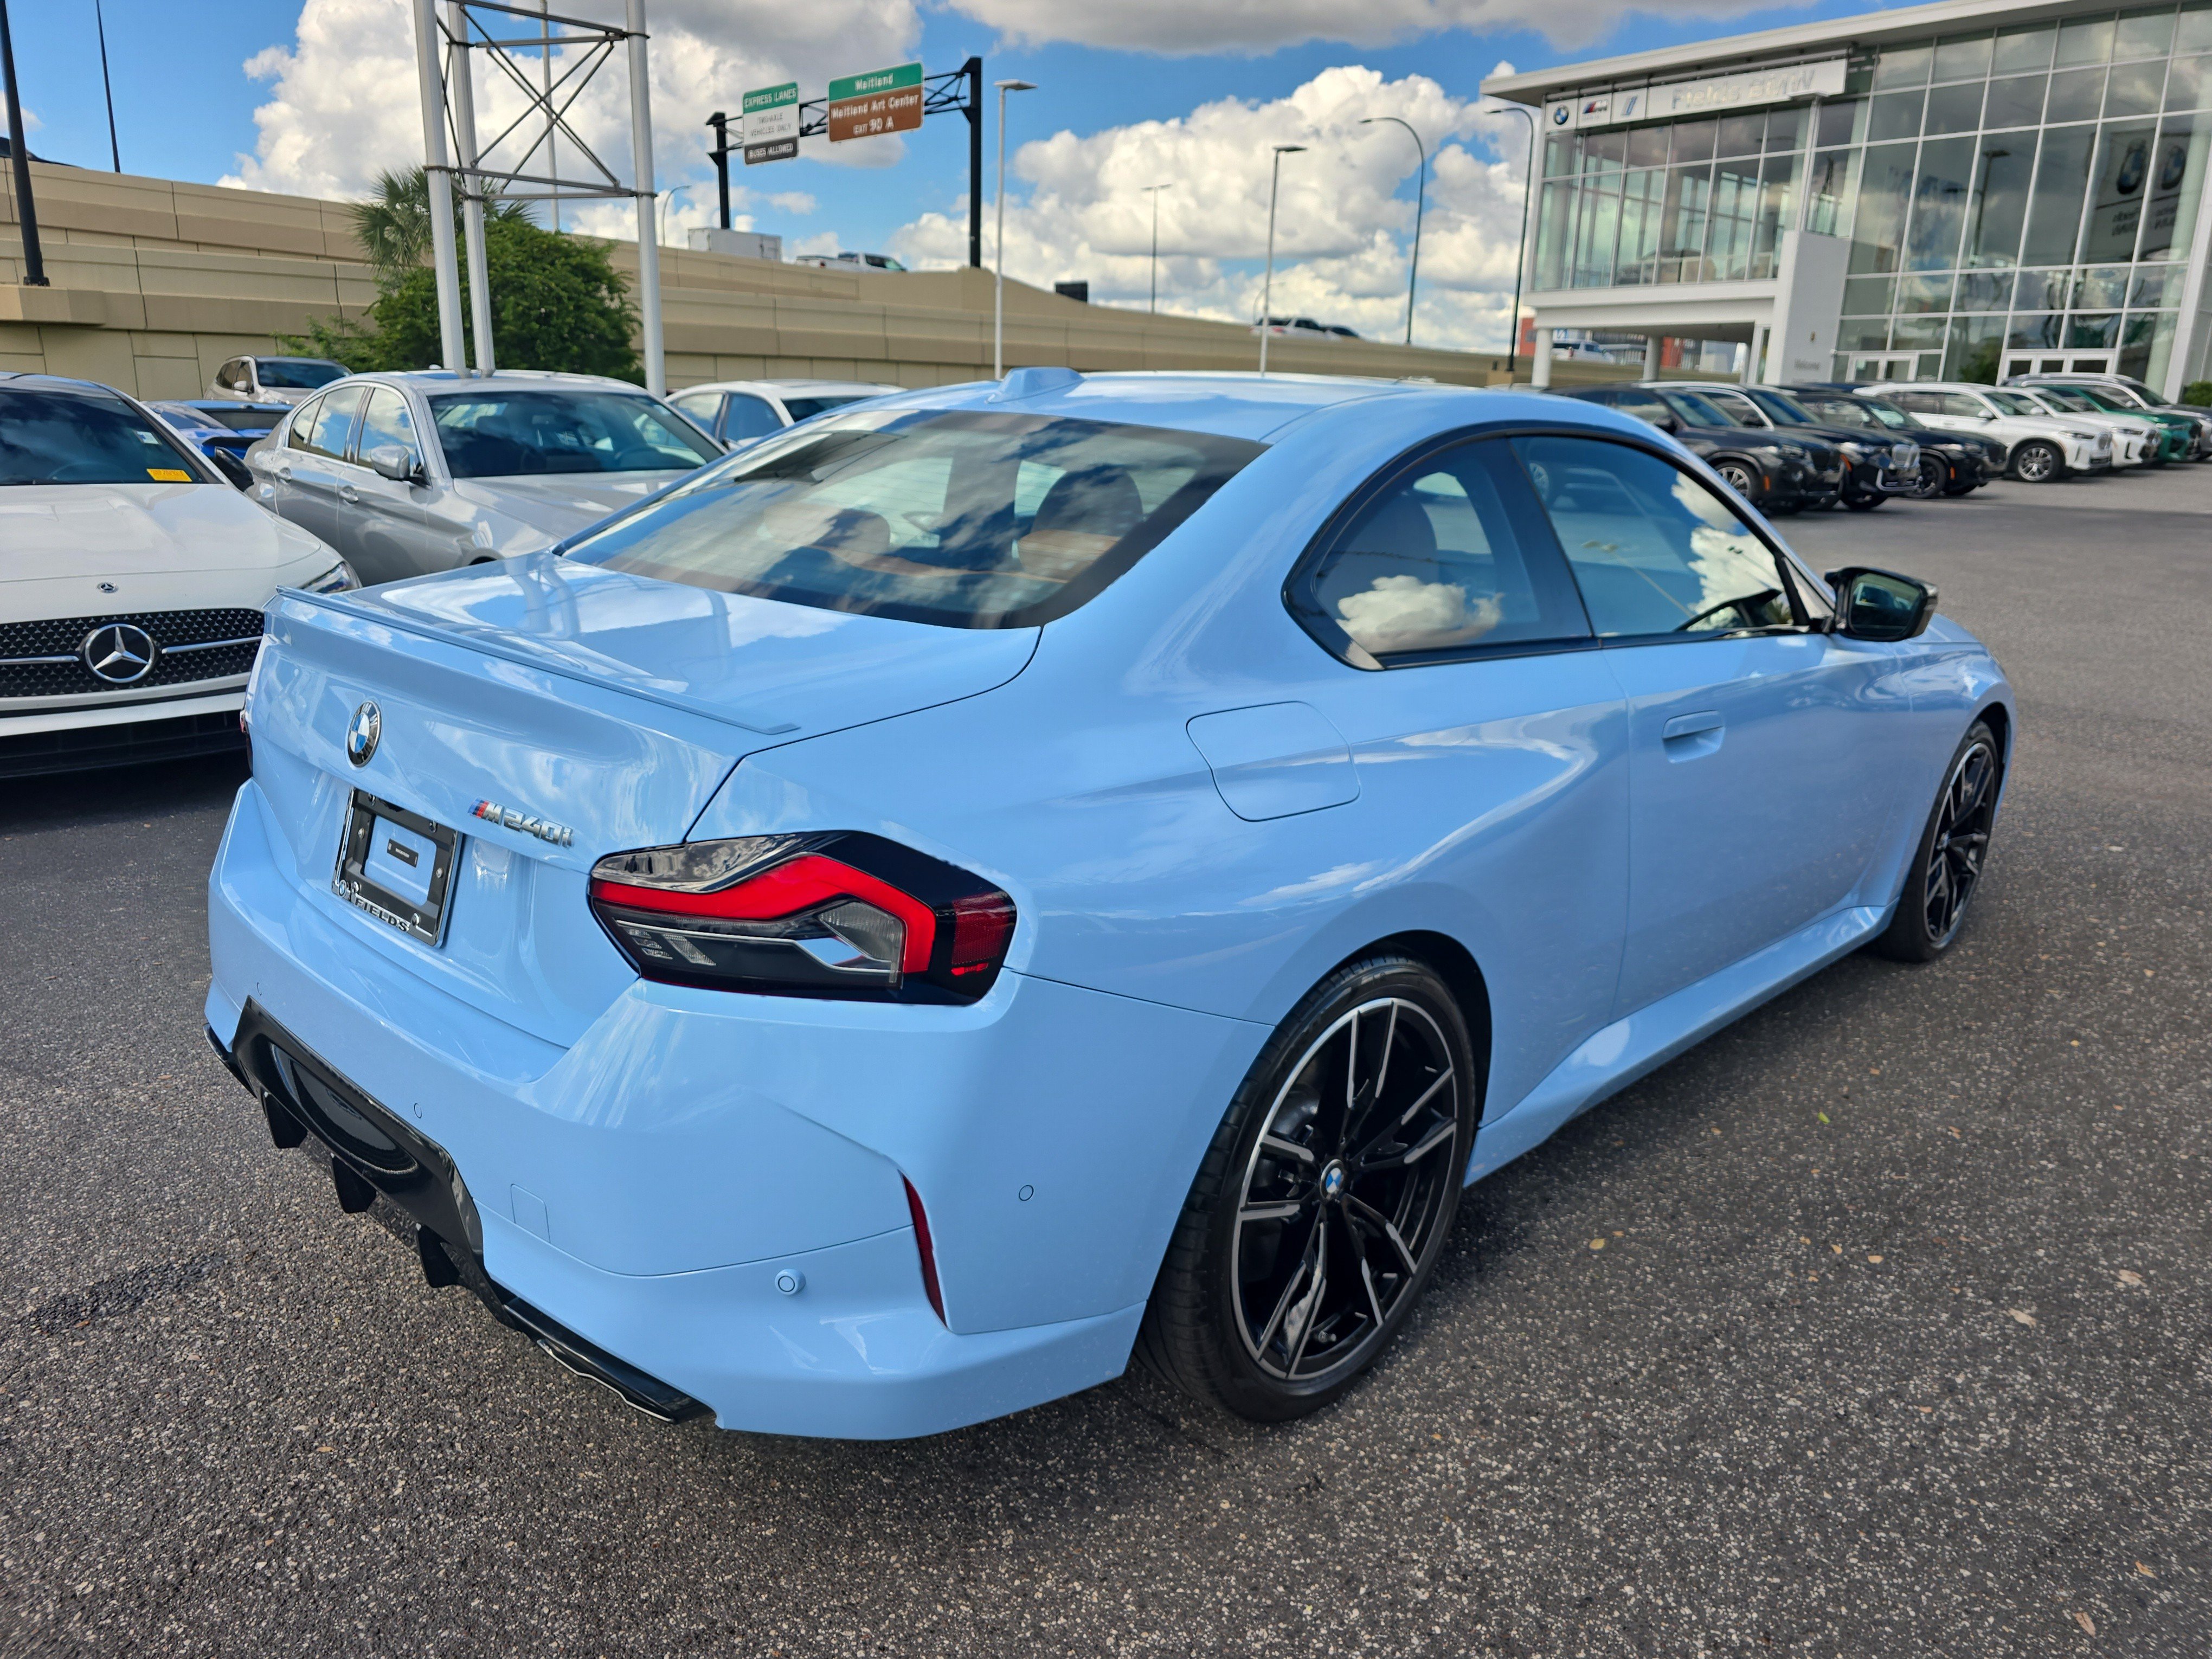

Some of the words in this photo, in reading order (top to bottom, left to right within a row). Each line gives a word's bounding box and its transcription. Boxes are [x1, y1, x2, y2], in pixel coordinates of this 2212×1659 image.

[855, 74, 893, 91] Maitland
[1671, 82, 1740, 109] Fields
[1748, 69, 1815, 99] BMW
[744, 93, 772, 108] EXPRESS
[775, 88, 796, 102] LANES
[831, 102, 868, 120] Maitland
[871, 99, 885, 113] Art
[888, 94, 919, 110] Center
[853, 124, 868, 135] EXIT
[869, 118, 883, 132] 90
[885, 116, 894, 130] A
[748, 147, 767, 159] BUSES
[767, 143, 793, 156] ALLOWED
[480, 801, 574, 849] M240i
[355, 897, 408, 932] FIELDS
